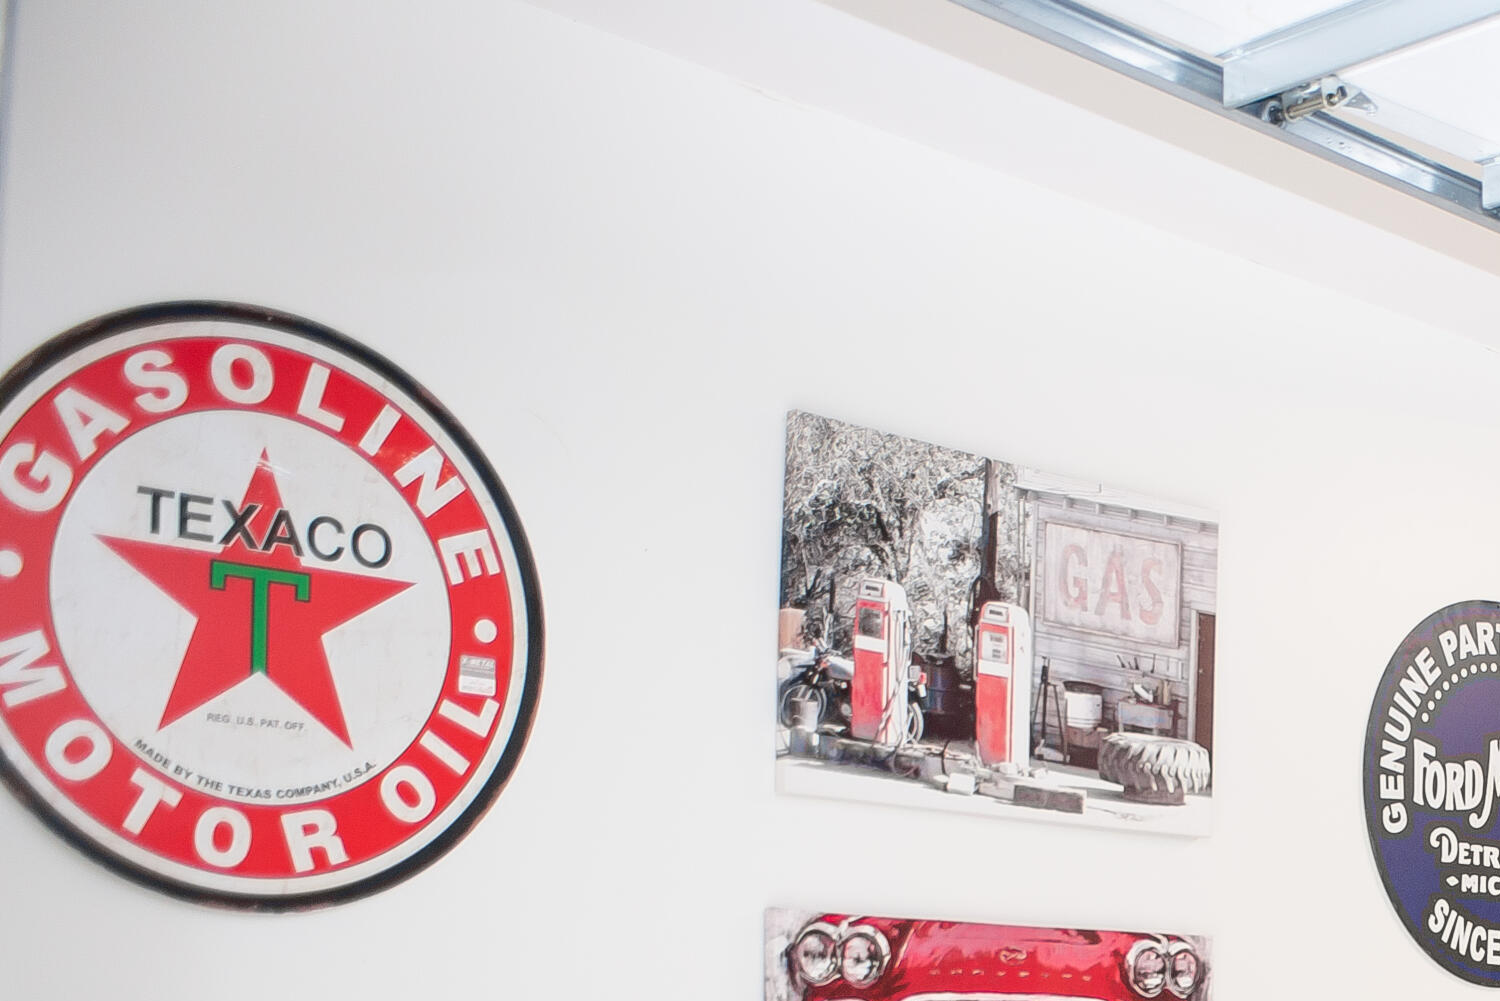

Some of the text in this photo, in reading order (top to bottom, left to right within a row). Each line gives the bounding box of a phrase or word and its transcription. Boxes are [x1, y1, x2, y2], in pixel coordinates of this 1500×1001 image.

[1, 343, 501, 585] GASOLINE
[136, 485, 393, 569] TEXACO
[1060, 543, 1165, 626] GAS
[0, 629, 500, 874] MOTOR OIL
[134, 739, 170, 769] MADE
[174, 764, 193, 780] BY
[196, 775, 223, 792] THE
[227, 785, 272, 800] TEXAS
[1379, 646, 1442, 834] GENUINE
